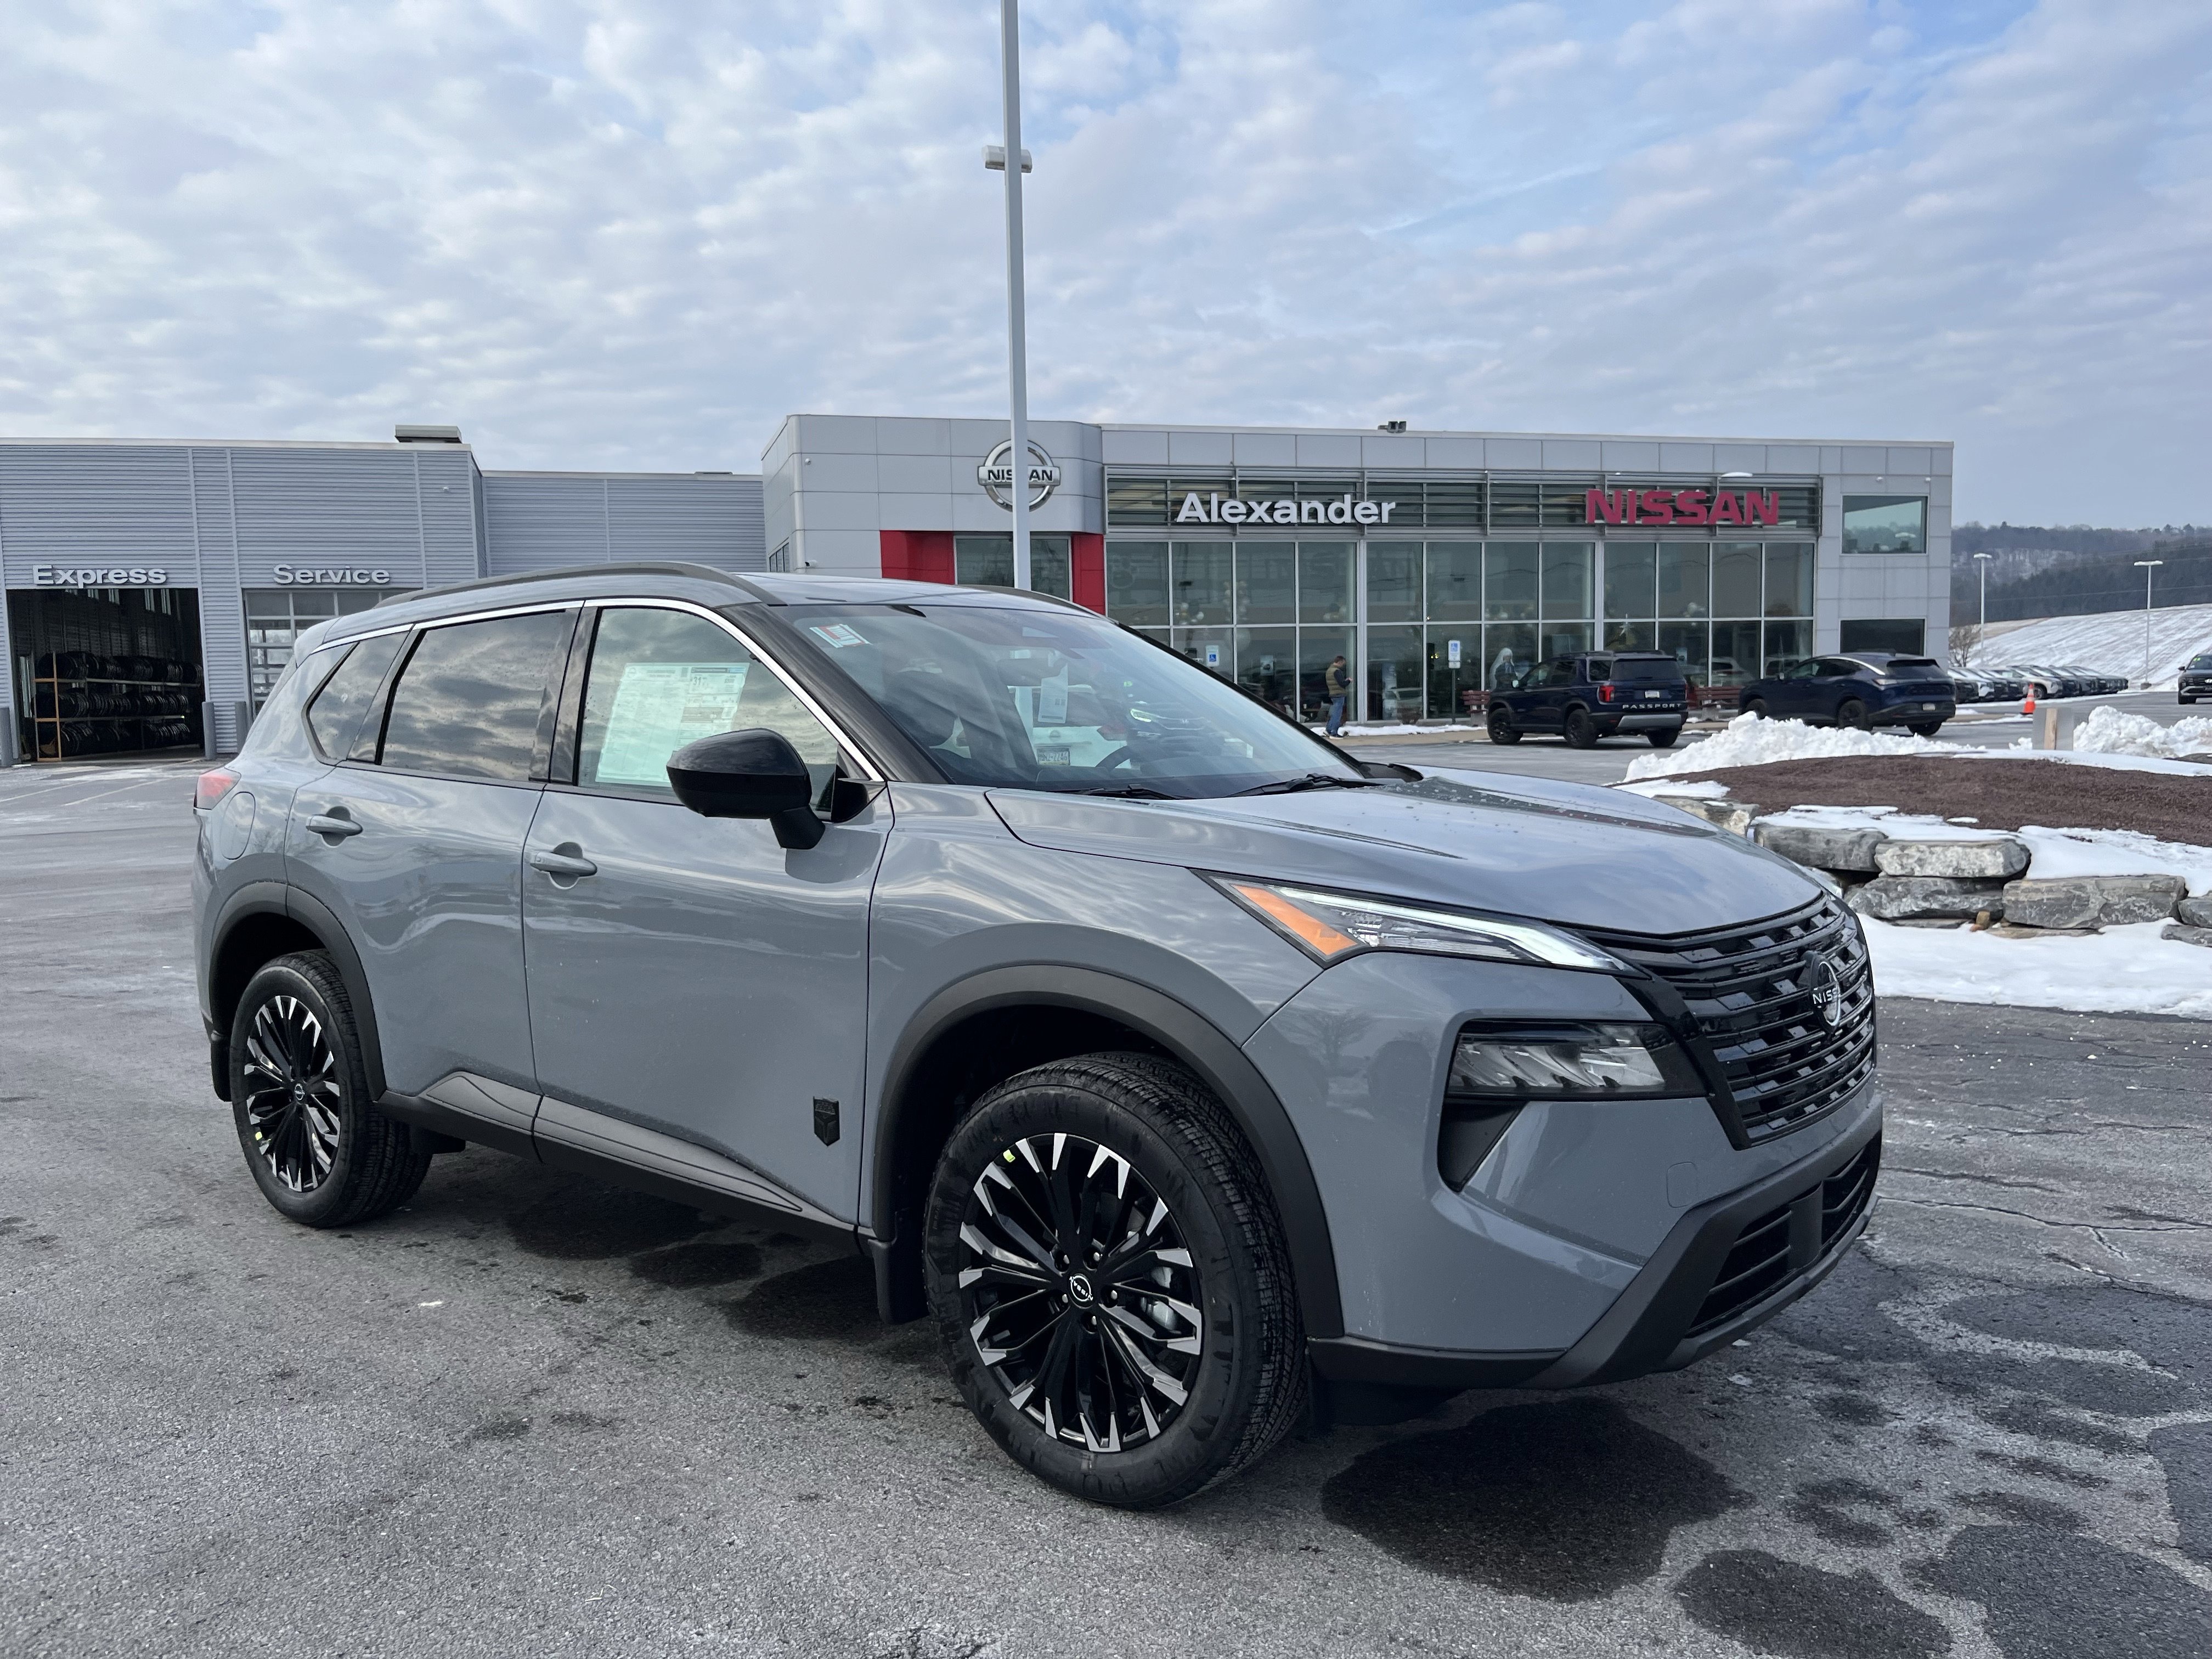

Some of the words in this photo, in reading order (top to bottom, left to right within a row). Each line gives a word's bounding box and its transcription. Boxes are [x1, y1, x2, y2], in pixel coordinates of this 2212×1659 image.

[988, 469, 1053, 482] NISAN
[1176, 493, 1396, 524] Alexander
[1585, 489, 1779, 525] NISSAN
[32, 564, 167, 589] Express
[273, 564, 390, 584] Service
[1812, 987, 1839, 1005] NISS
